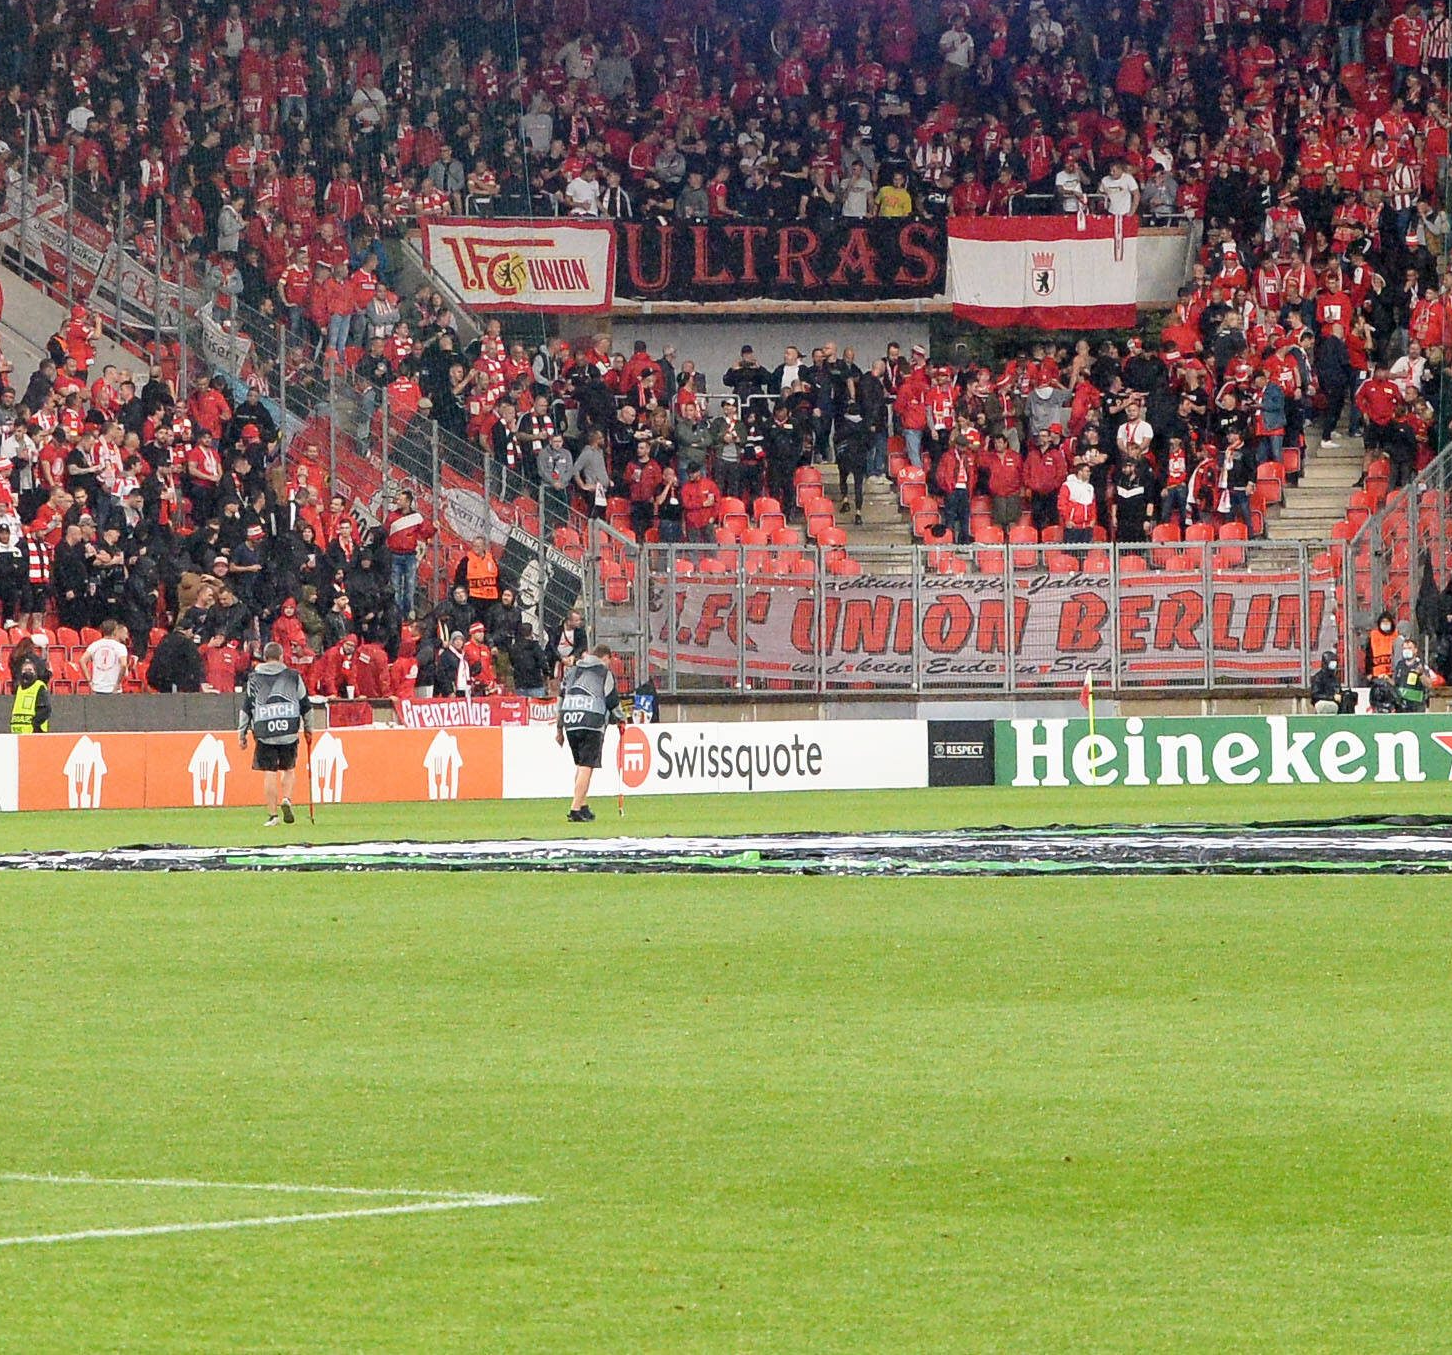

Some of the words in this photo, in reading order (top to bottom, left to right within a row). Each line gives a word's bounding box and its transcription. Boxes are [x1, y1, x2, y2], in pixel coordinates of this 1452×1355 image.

[442, 237, 556, 296] 1.FC
[528, 258, 591, 292] UNION
[622, 222, 940, 293] ULTRAS
[790, 594, 1030, 655] UNION
[1057, 589, 1326, 654] BERLIN
[259, 704, 295, 720] PITCH
[268, 719, 289, 733] 009
[401, 698, 491, 728] Grenzenlos
[563, 711, 584, 724] 007
[657, 731, 823, 791] Swissquote
[946, 745, 985, 757] RESPECT
[1011, 716, 1428, 787] Heineken
